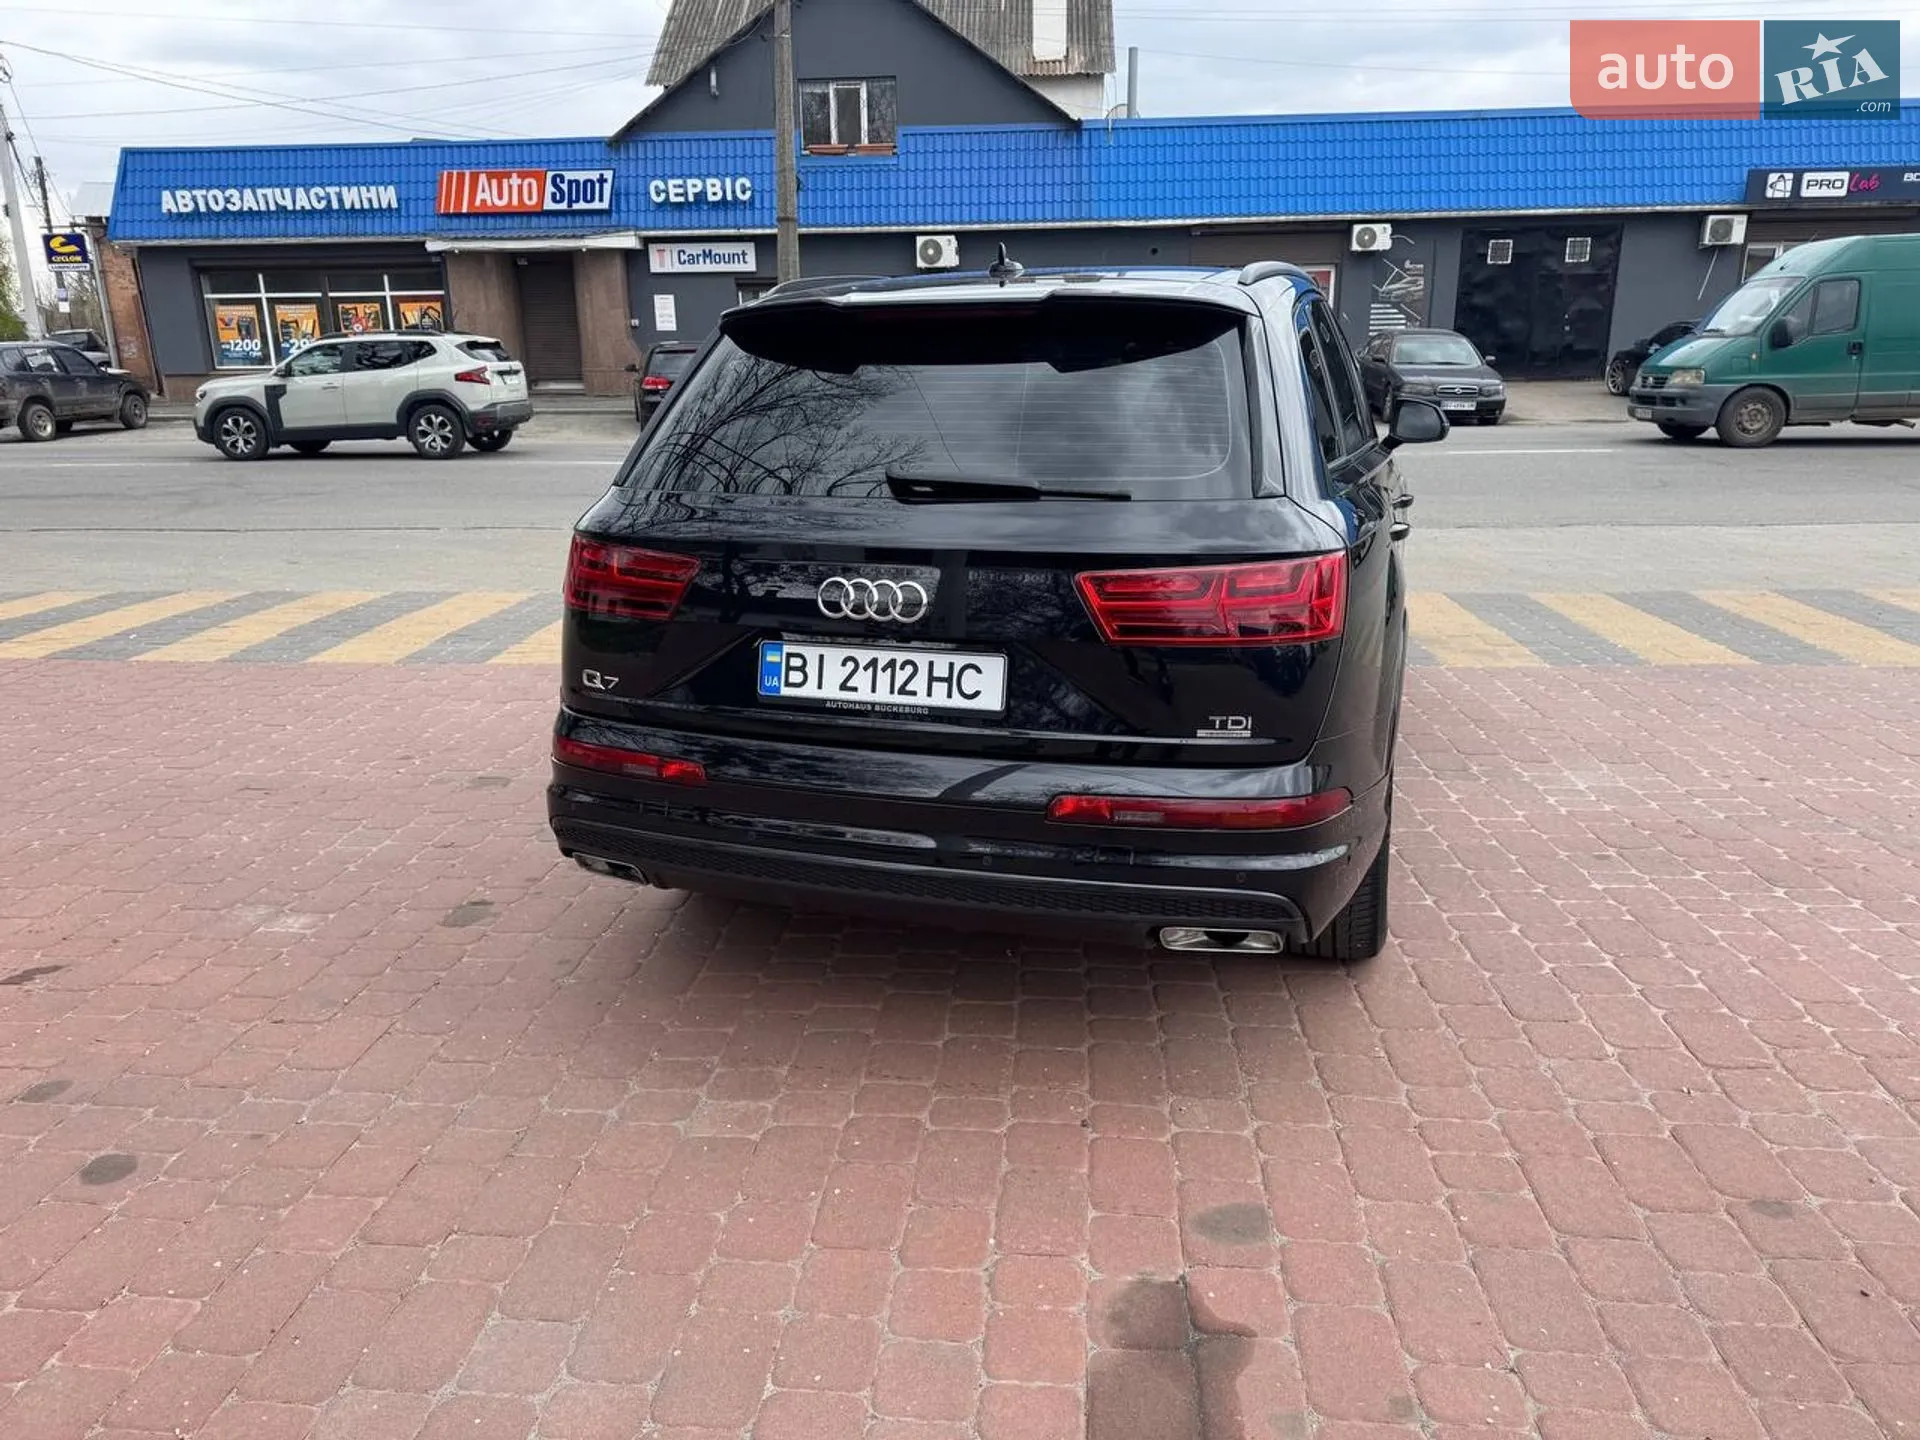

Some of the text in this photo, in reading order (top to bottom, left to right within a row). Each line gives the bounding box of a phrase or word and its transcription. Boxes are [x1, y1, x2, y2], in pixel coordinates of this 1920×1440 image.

[474, 172, 608, 208] Auto Spot
[650, 177, 752, 203] СЕРВІС
[1806, 172, 1880, 192] PRO Lab
[161, 185, 398, 213] АВТОЗАПЧАСТИНИ
[677, 248, 749, 265] CarMount
[230, 339, 261, 352] 1200
[583, 669, 619, 690] Q7
[764, 676, 779, 688] UA
[783, 652, 983, 700] BI 2112 HC
[825, 700, 872, 711] AUTOHAUS
[1209, 715, 1252, 729] TDI
